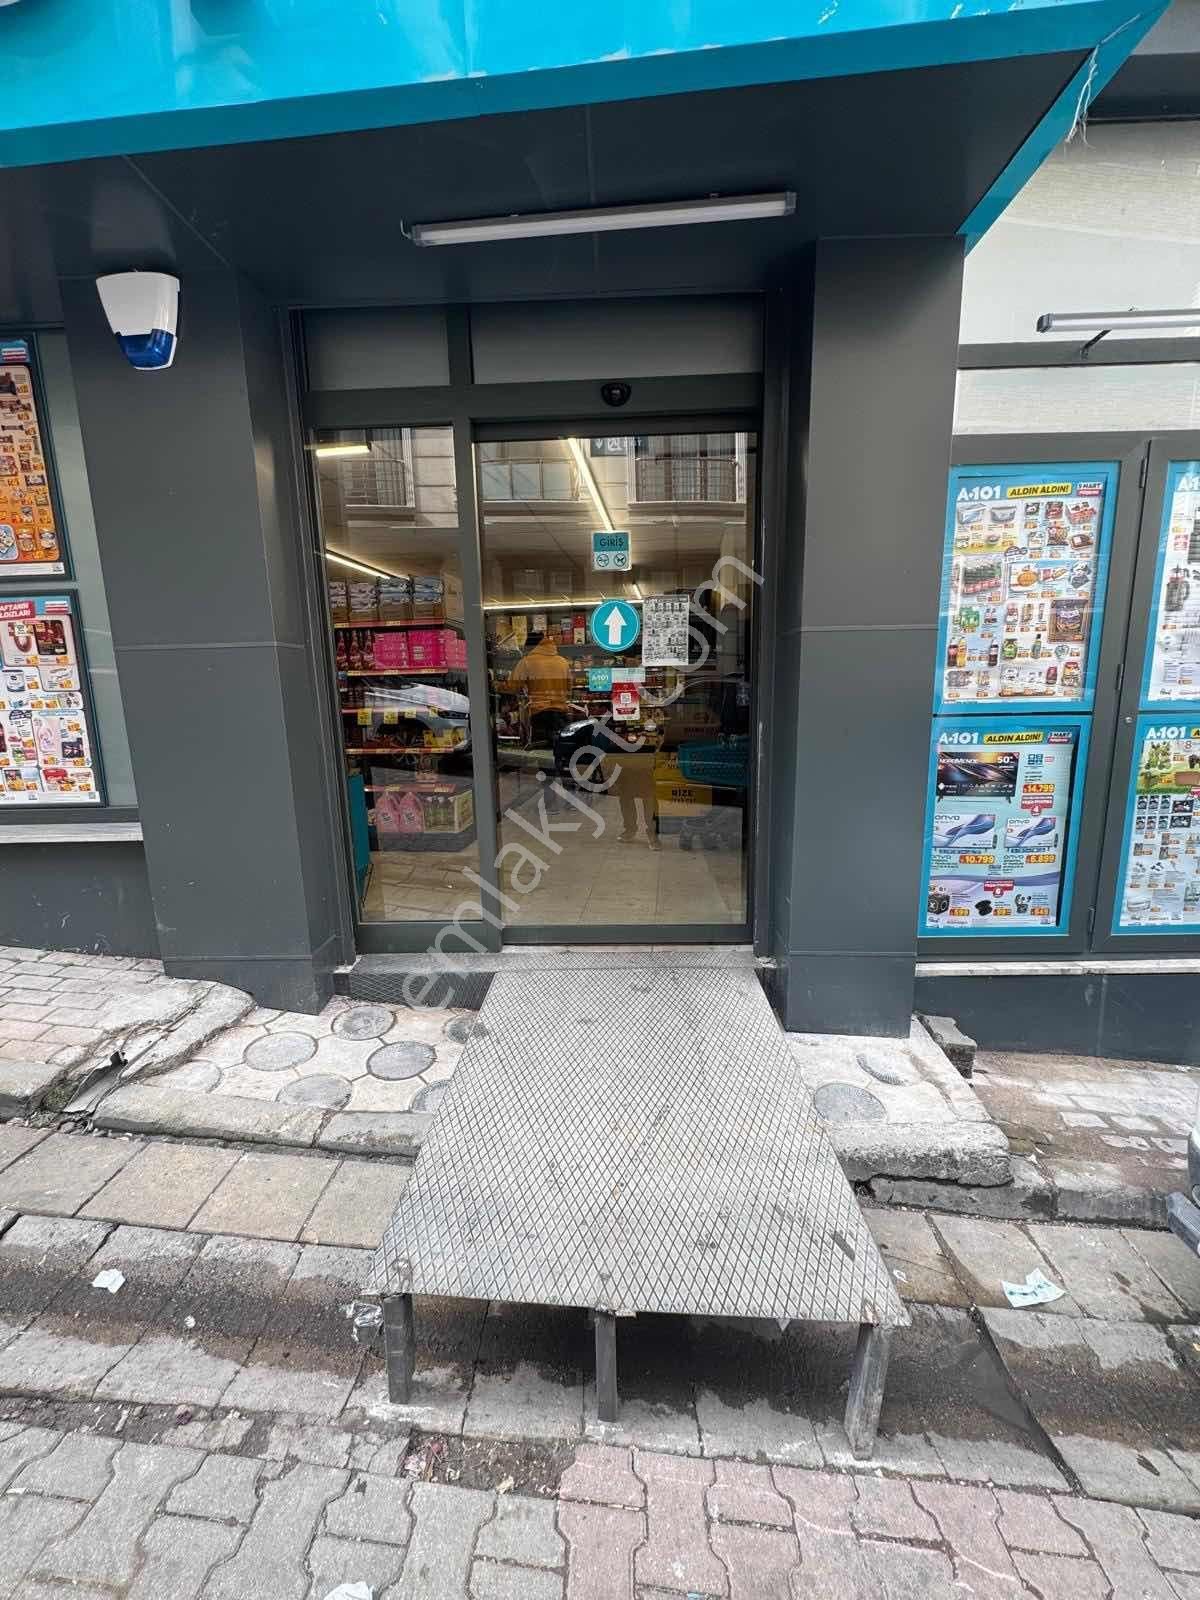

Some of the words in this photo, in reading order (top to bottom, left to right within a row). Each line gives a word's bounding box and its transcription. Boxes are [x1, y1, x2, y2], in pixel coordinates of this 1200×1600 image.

[1010, 486, 1039, 496] ALDIN
[1040, 484, 1069, 494] ALDIN!
[986, 734, 1014, 743] ALDIN
[1014, 732, 1041, 741] ALDIN!
